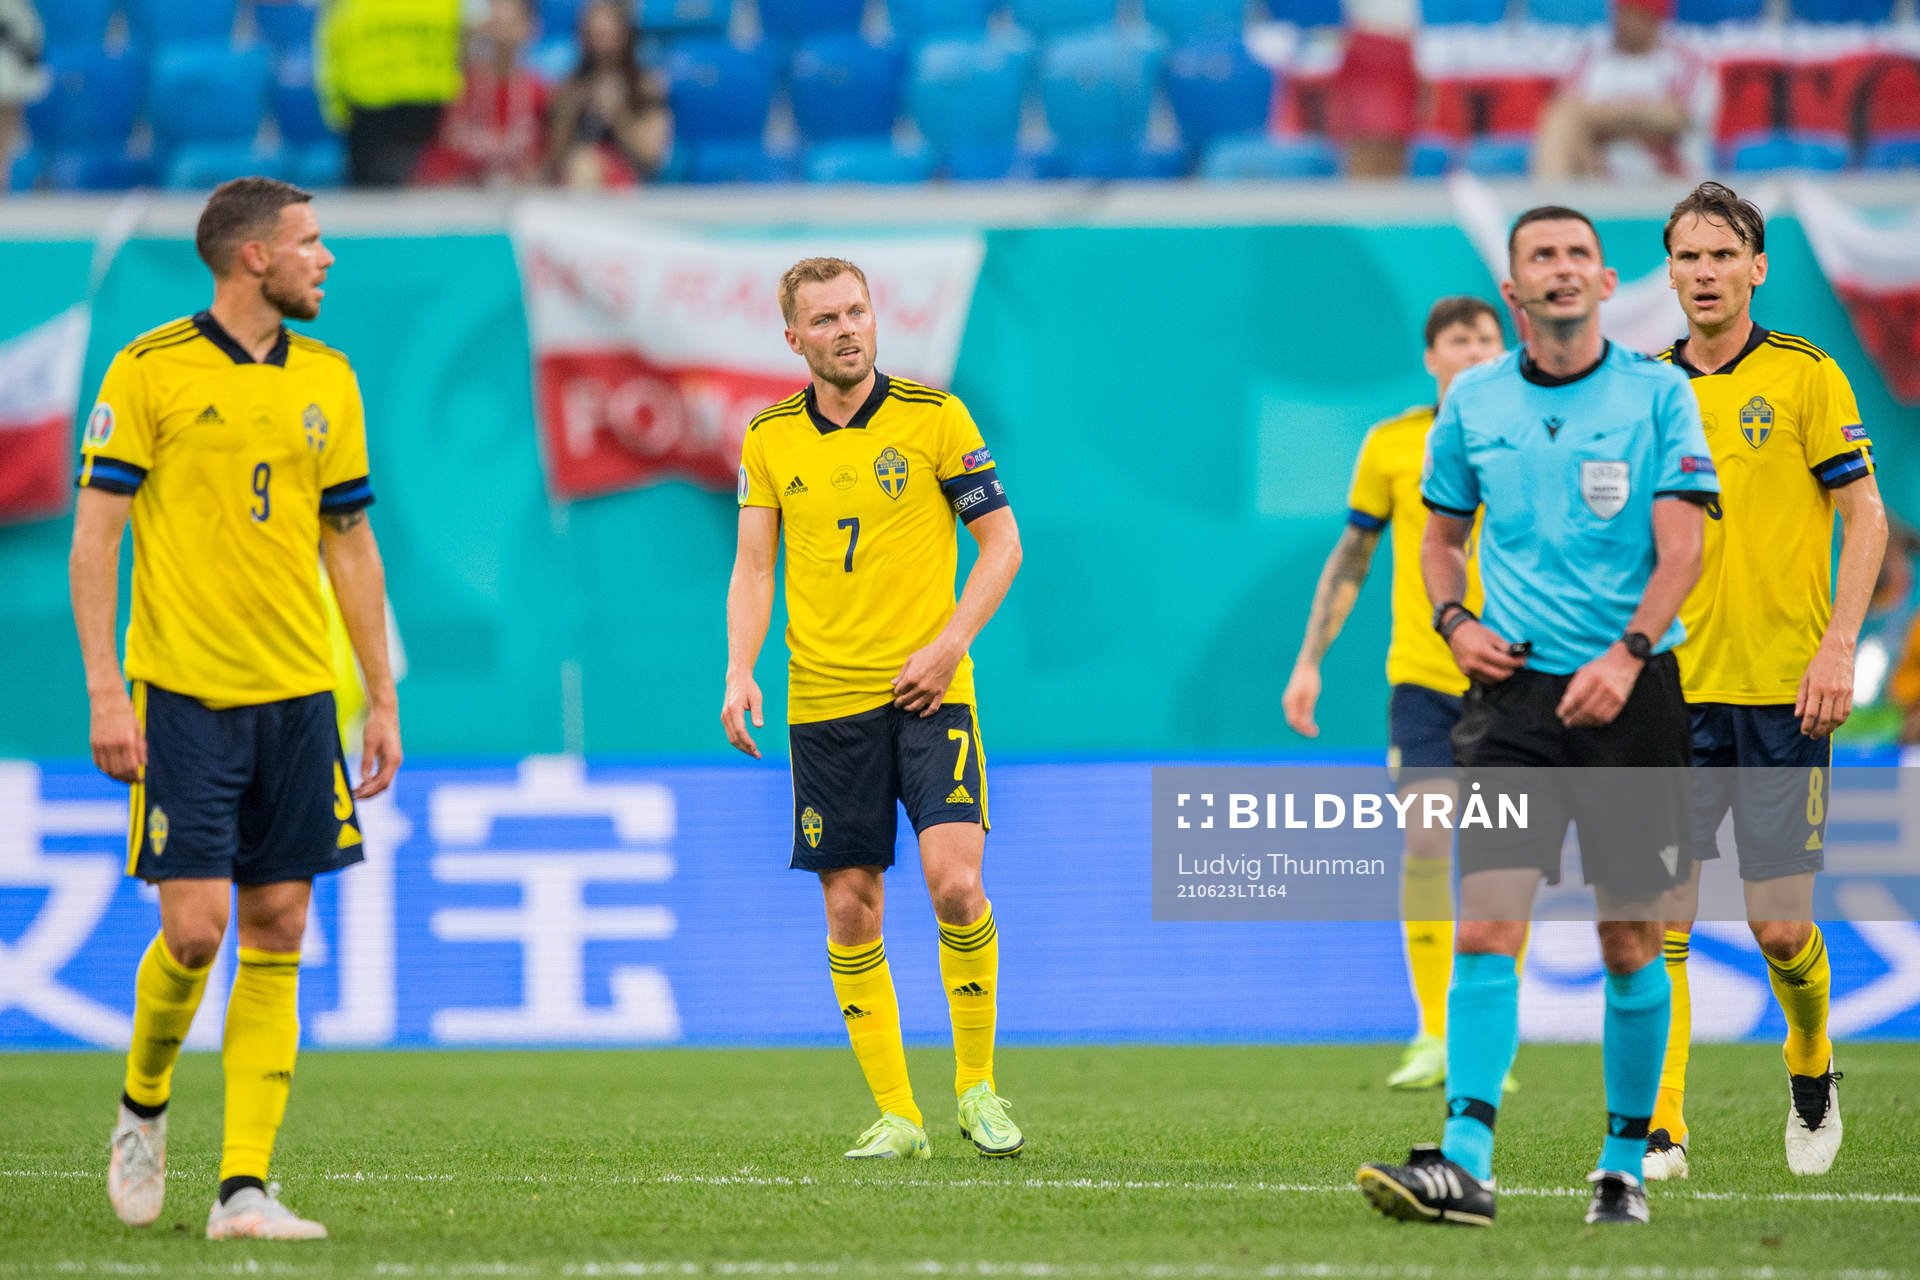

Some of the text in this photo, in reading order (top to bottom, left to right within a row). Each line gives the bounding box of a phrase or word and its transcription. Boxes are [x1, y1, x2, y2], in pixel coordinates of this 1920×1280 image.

[251, 462, 271, 522] 9
[784, 486, 809, 497] adidas
[837, 517, 860, 573] 7
[948, 728, 970, 781] 7
[1806, 767, 1824, 826] 8
